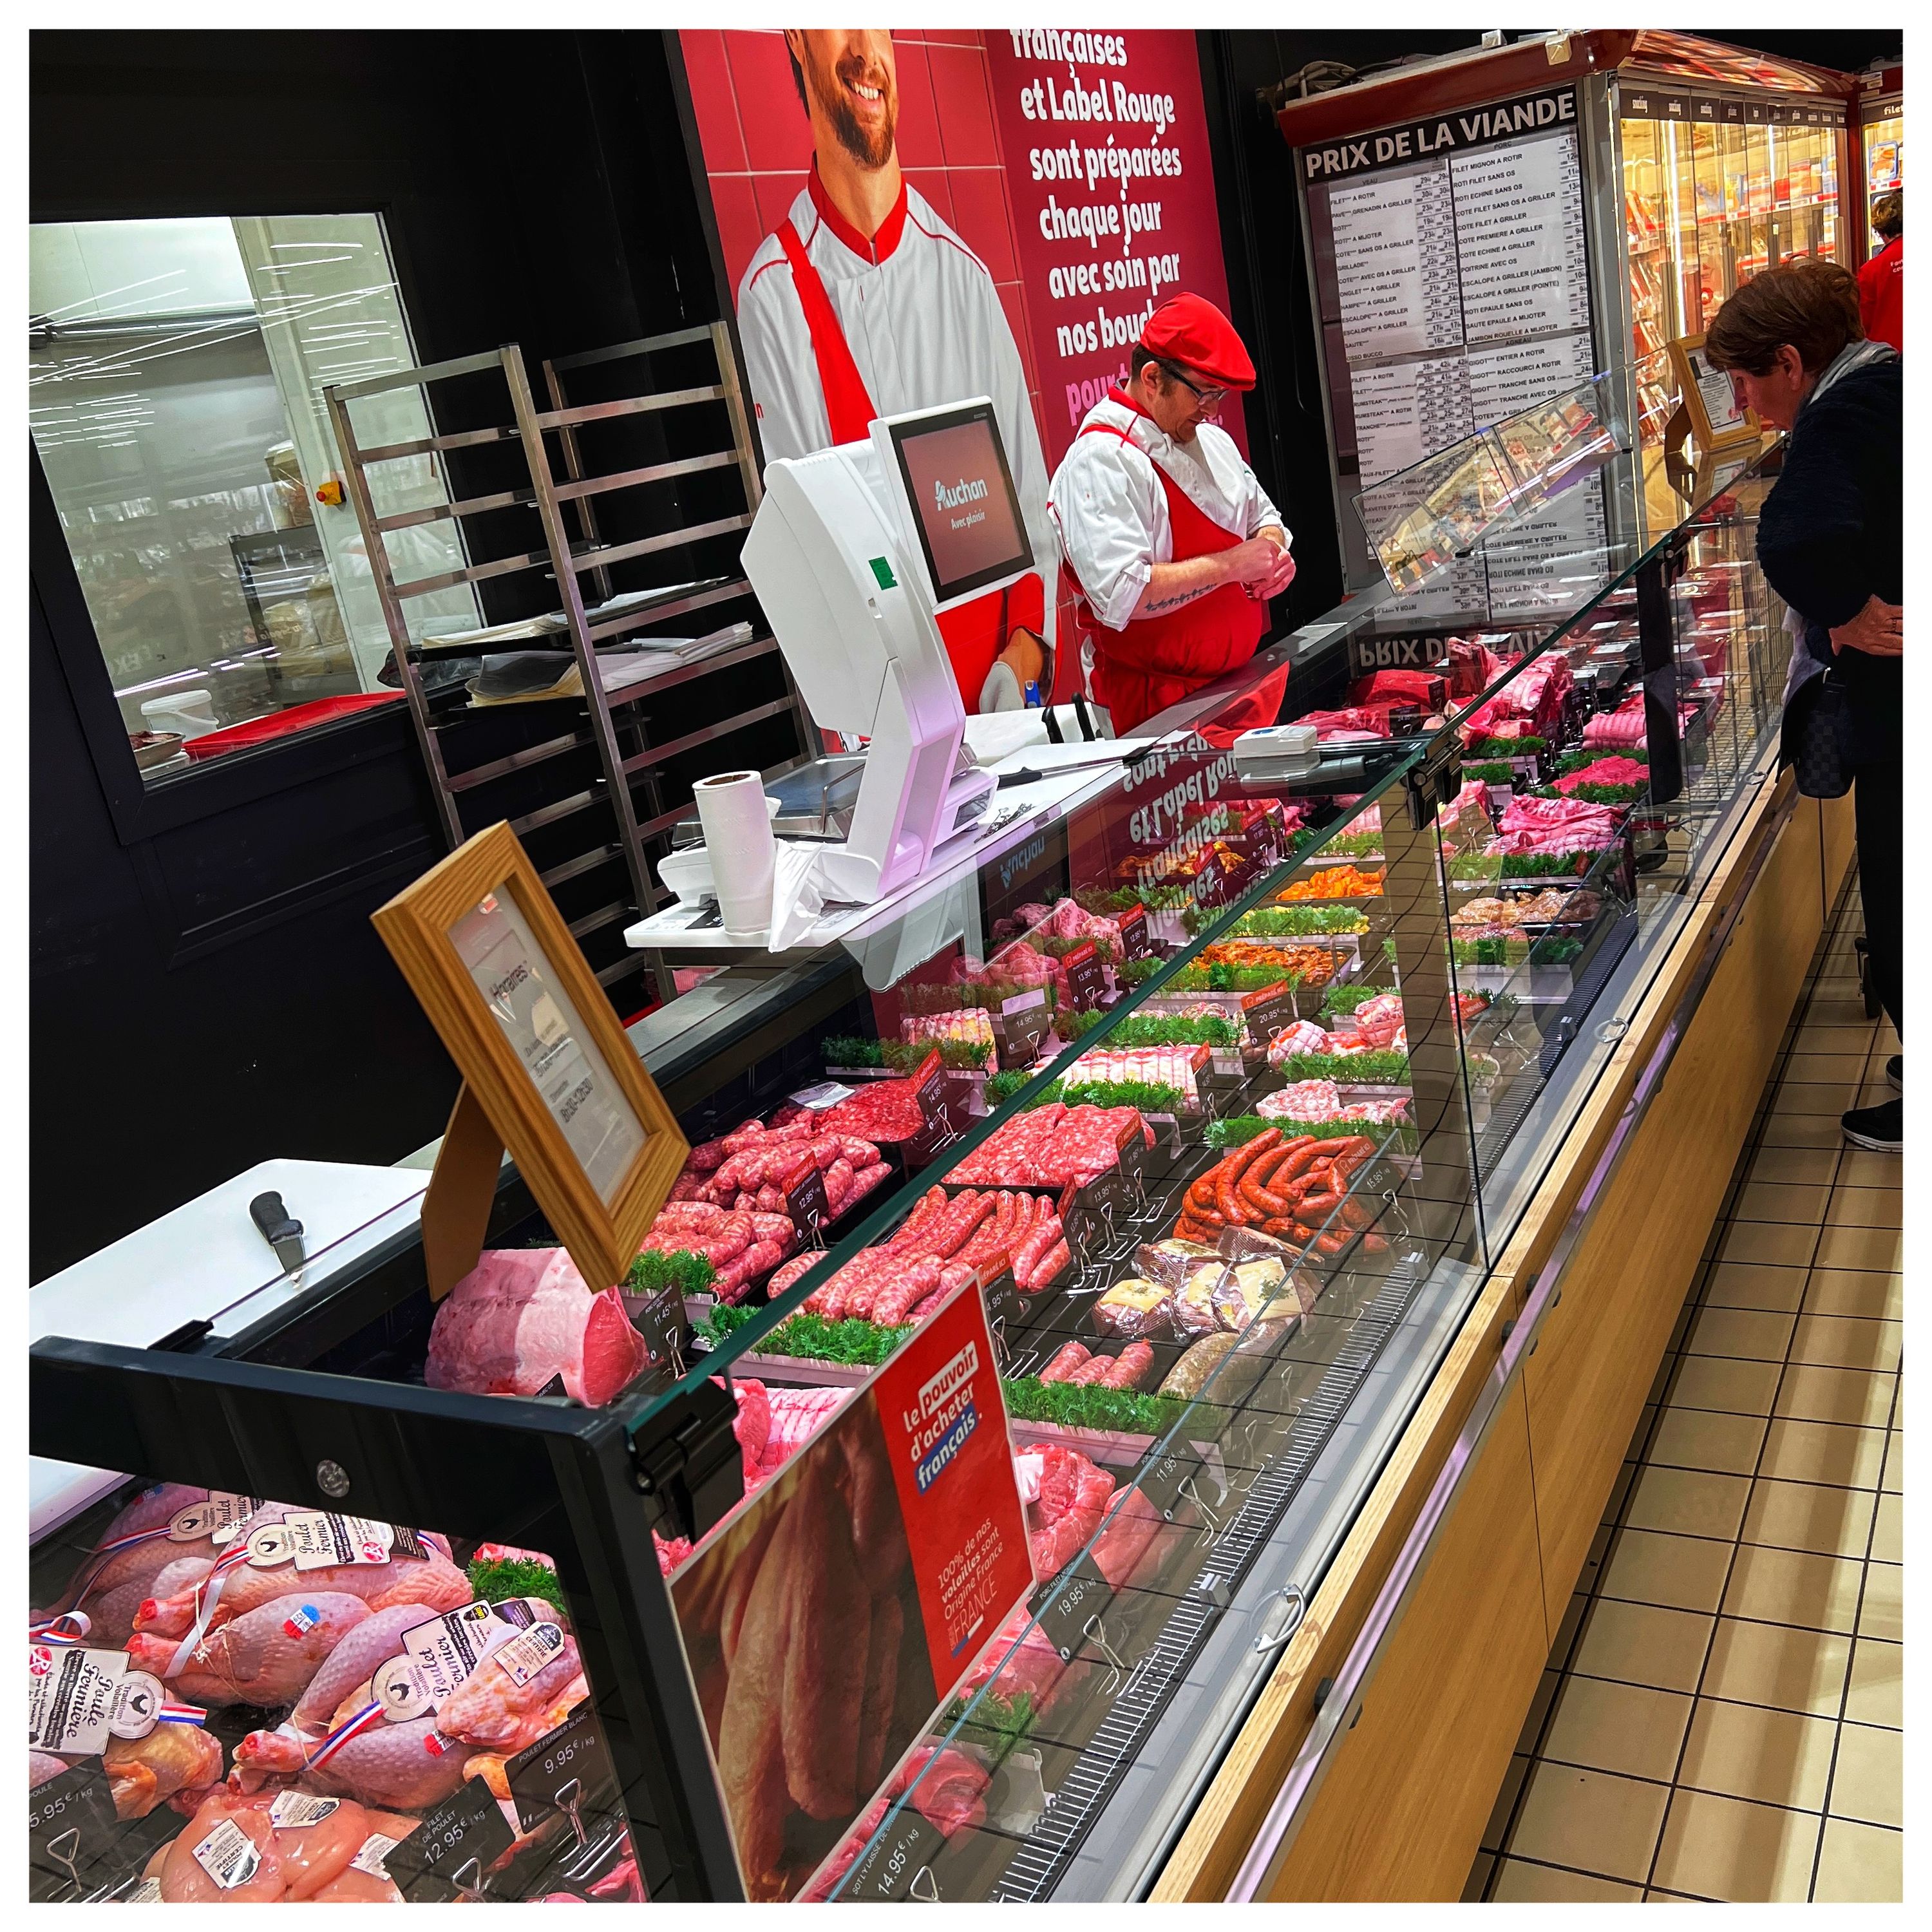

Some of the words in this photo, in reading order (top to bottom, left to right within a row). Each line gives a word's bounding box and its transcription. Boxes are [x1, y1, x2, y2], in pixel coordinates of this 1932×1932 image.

[1010, 29, 1127, 78] françaises
[1021, 79, 1048, 120] et
[1046, 77, 1113, 122] Label
[1112, 80, 1175, 135] Rouge
[1305, 140, 1370, 178] PRIX
[1376, 131, 1412, 162] DE
[1417, 122, 1455, 153] LA
[1459, 92, 1576, 142] VIANDE
[1030, 139, 1083, 180] sont
[1084, 133, 1182, 191] préparées
[1452, 165, 1468, 173] FILET
[1470, 160, 1495, 170] MIGNON
[1502, 154, 1522, 163] ROTIR
[1469, 176, 1486, 185] FILET
[1488, 173, 1505, 181] SANS
[1470, 191, 1493, 200] ECHINE
[1495, 186, 1512, 194] SANS
[1039, 194, 1120, 249] chaque
[1120, 189, 1161, 245] jour
[1456, 209, 1473, 217] COTE
[1473, 205, 1491, 213] FILET
[1492, 202, 1510, 210] SANS
[1528, 191, 1555, 202] GRILLER
[1457, 223, 1474, 231] COTE
[1475, 218, 1492, 227] FILET
[1499, 213, 1527, 223] GRILLER
[1477, 231, 1508, 242] PREMIERE
[1515, 224, 1543, 234] GRILLER
[1460, 251, 1476, 259] COTE
[1477, 246, 1501, 256] ECHINE
[1508, 240, 1535, 251] GRILLER
[1049, 263, 1101, 299] avec
[1103, 244, 1147, 292] soin
[1148, 253, 1180, 296] par
[1461, 263, 1489, 273] POITRINE
[1490, 260, 1507, 268] AVEC
[1462, 277, 1495, 287] ESCALOPE
[1502, 271, 1530, 281] GRILLER
[1530, 265, 1562, 278] (JAMBON)
[1463, 290, 1496, 301] ESCALOPE
[1503, 285, 1530, 295] GRILLER
[1531, 280, 1559, 291] (POINTE)
[1466, 321, 1486, 329] SAUTE
[1487, 316, 1511, 326] EPAULE
[1480, 303, 1504, 313] EPAULE
[1056, 320, 1098, 357] nos
[1467, 334, 1493, 343] JAMBON
[1494, 329, 1523, 339] ROUELLE
[1499, 379, 1527, 390] TRANCHE
[935, 478, 988, 511] Auchan
[951, 518, 966, 530] Avec
[966, 508, 985, 528] plaisir
[1258, 1007, 1280, 1024] 20.95€
[983, 1260, 1000, 1279] ÉPARÉ
[986, 1290, 1003, 1312] 4.95€
[903, 1408, 920, 1434] le
[922, 1348, 974, 1414] pouvoir
[911, 1381, 974, 1463] d'acheter
[216, 1499, 232, 1530] Poulet
[294, 1522, 315, 1554] Poulet
[312, 1519, 333, 1555] Fermier
[938, 1550, 964, 1589] 100%
[965, 1539, 976, 1557] de
[976, 1517, 992, 1543] nos
[941, 1550, 981, 1604] volailles
[981, 1526, 1000, 1556] sont
[944, 1577, 976, 1621] Origine
[976, 1541, 1003, 1582] France
[1039, 1586, 1052, 1600] PORC
[1050, 1573, 1063, 1589] FILET
[1058, 1581, 1084, 1616] 19.95€
[952, 1569, 998, 1645] FRANCE
[407, 1667, 425, 1700] Tradition
[419, 1647, 451, 1698] Poulet
[66, 1663, 100, 1739] Fermière
[87, 1676, 113, 1727] Poule
[116, 1685, 132, 1720] Tradition
[519, 1742, 542, 1763] POULET
[542, 1725, 569, 1748] FERMIER
[568, 1711, 589, 1729] BLANC
[544, 1739, 580, 1774] 9.95€
[585, 1736, 596, 1747] kg
[80, 1787, 93, 1799] kg
[422, 1832, 433, 1843] DE
[431, 1810, 456, 1835] POULET
[426, 1810, 444, 1829] FILET
[424, 1817, 468, 1864] 12.95€
[473, 1810, 486, 1822] kg
[852, 1878, 863, 1895] SOT
[865, 1842, 882, 1868] LAISSE
[878, 1840, 906, 1895] 14.95€
[907, 1828, 920, 1841] kg
